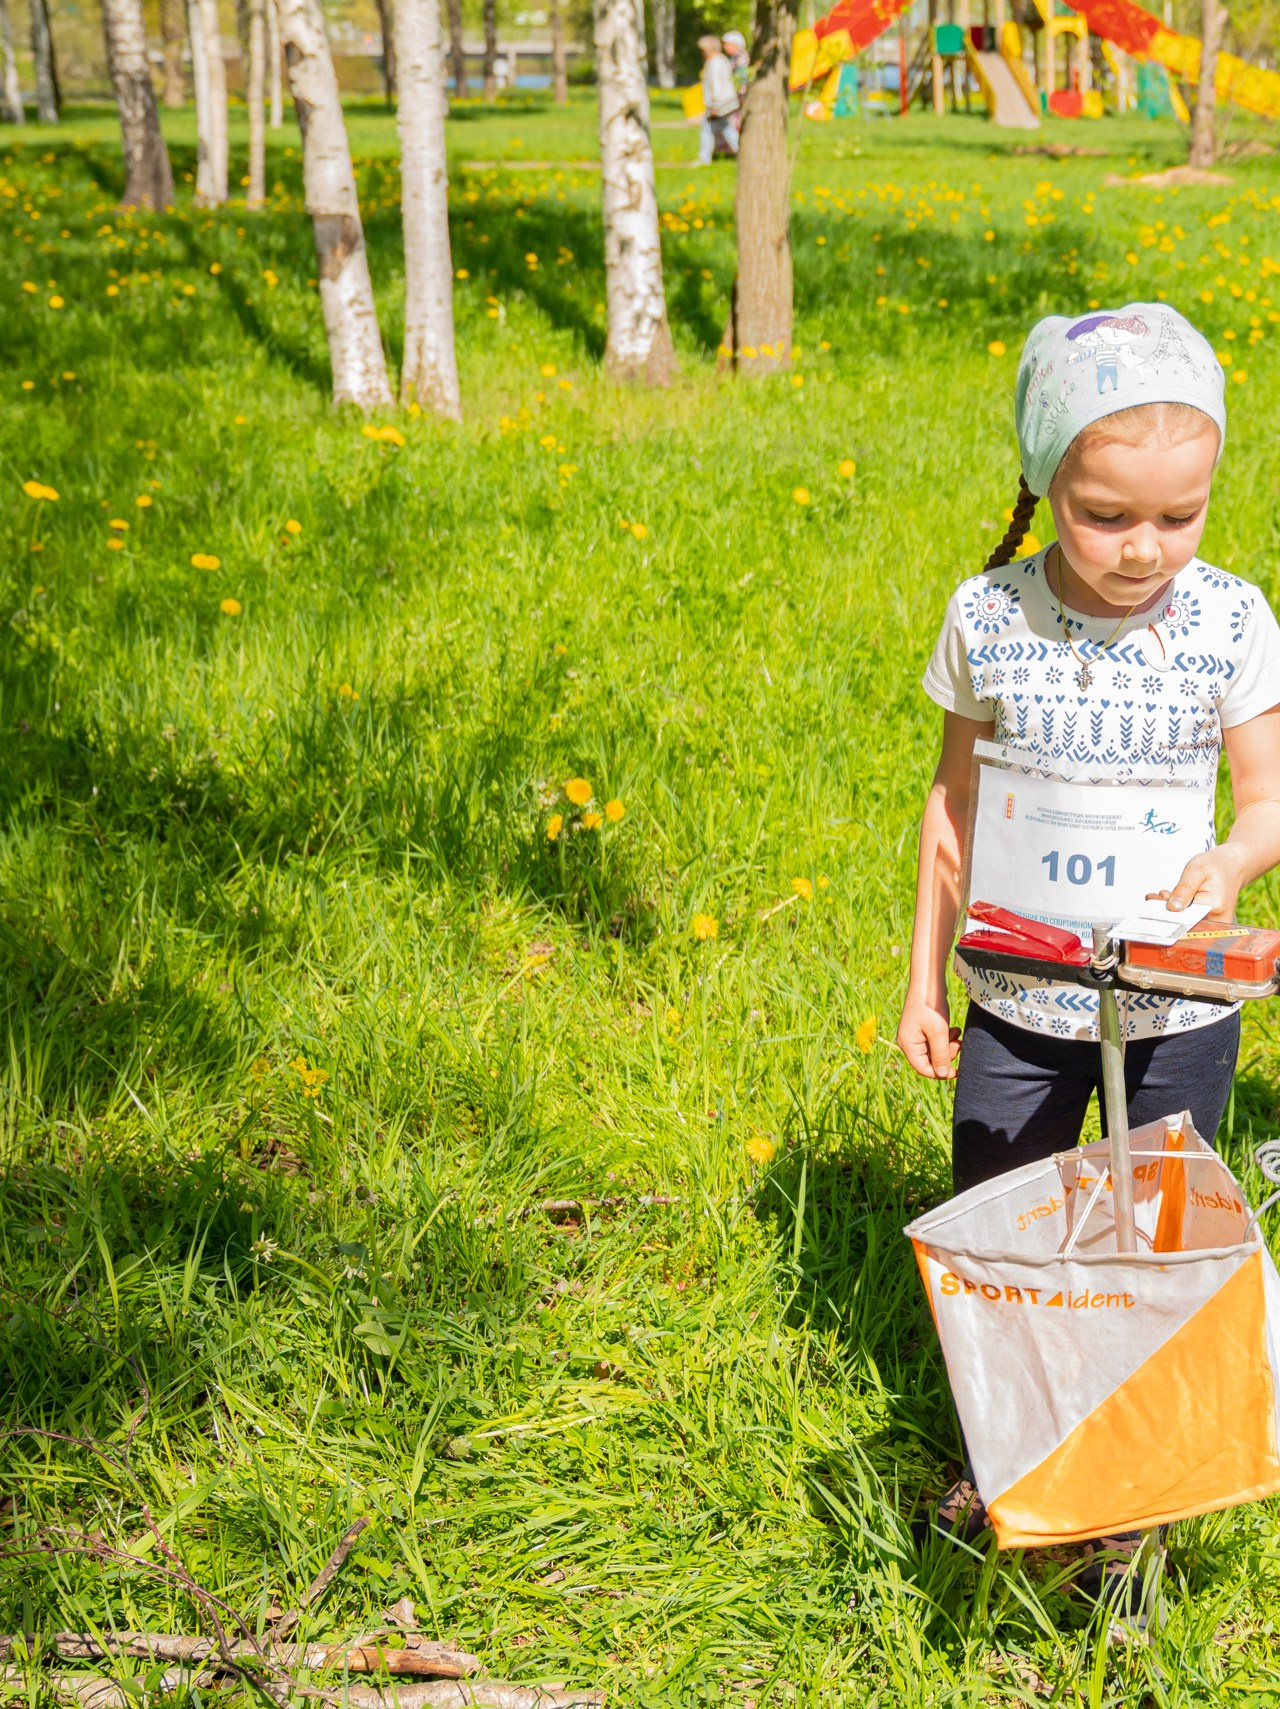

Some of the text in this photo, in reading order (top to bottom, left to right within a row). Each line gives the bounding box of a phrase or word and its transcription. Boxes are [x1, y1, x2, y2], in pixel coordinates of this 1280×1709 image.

[1042, 850, 1115, 886] 101
[1040, 916, 1048, 924] ПО
[1049, 917, 1093, 929] СПОРТИВНОМ
